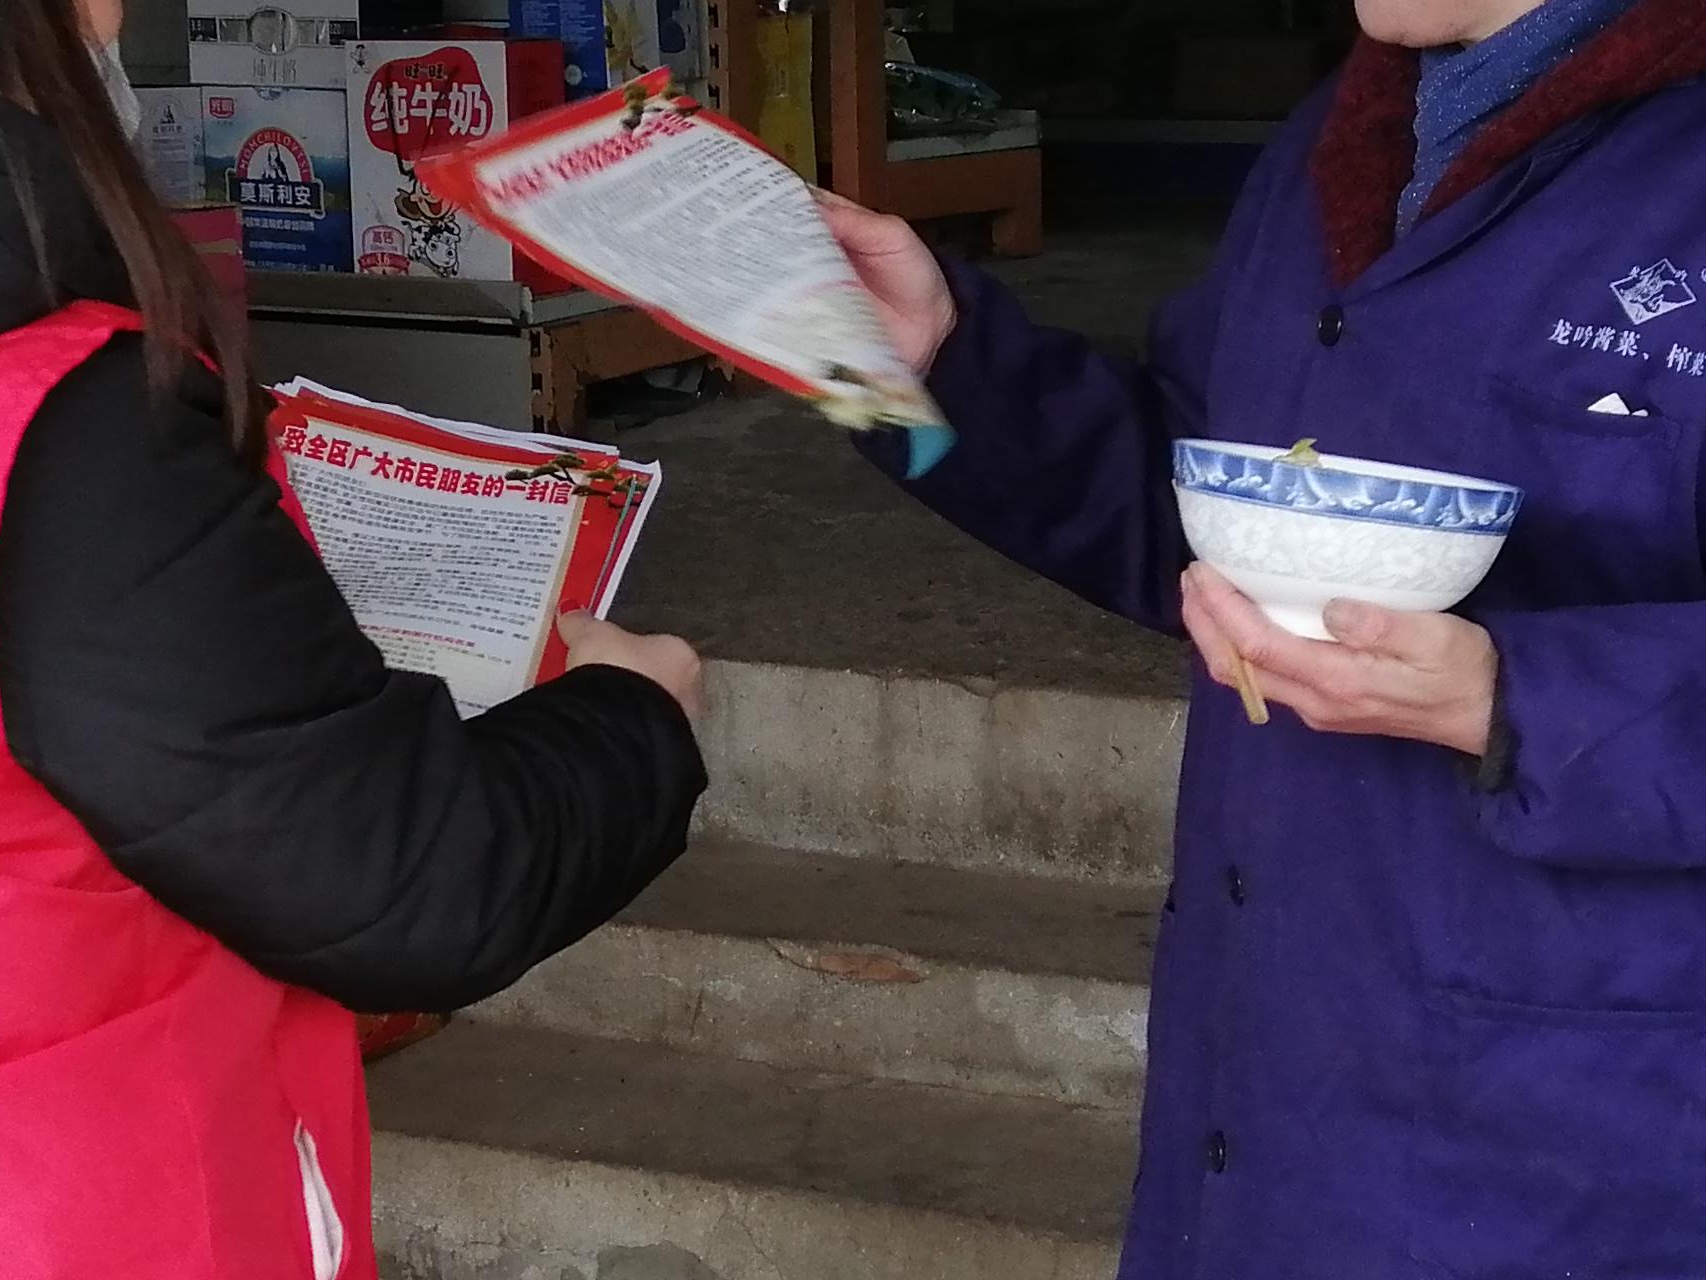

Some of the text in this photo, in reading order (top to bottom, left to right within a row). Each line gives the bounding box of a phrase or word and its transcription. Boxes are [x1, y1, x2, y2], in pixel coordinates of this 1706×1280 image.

[370, 82, 489, 136] 纯牛奶
[240, 183, 312, 206] 莫斯利安
[282, 424, 575, 505] 致全区广大市民朋友的一封信
